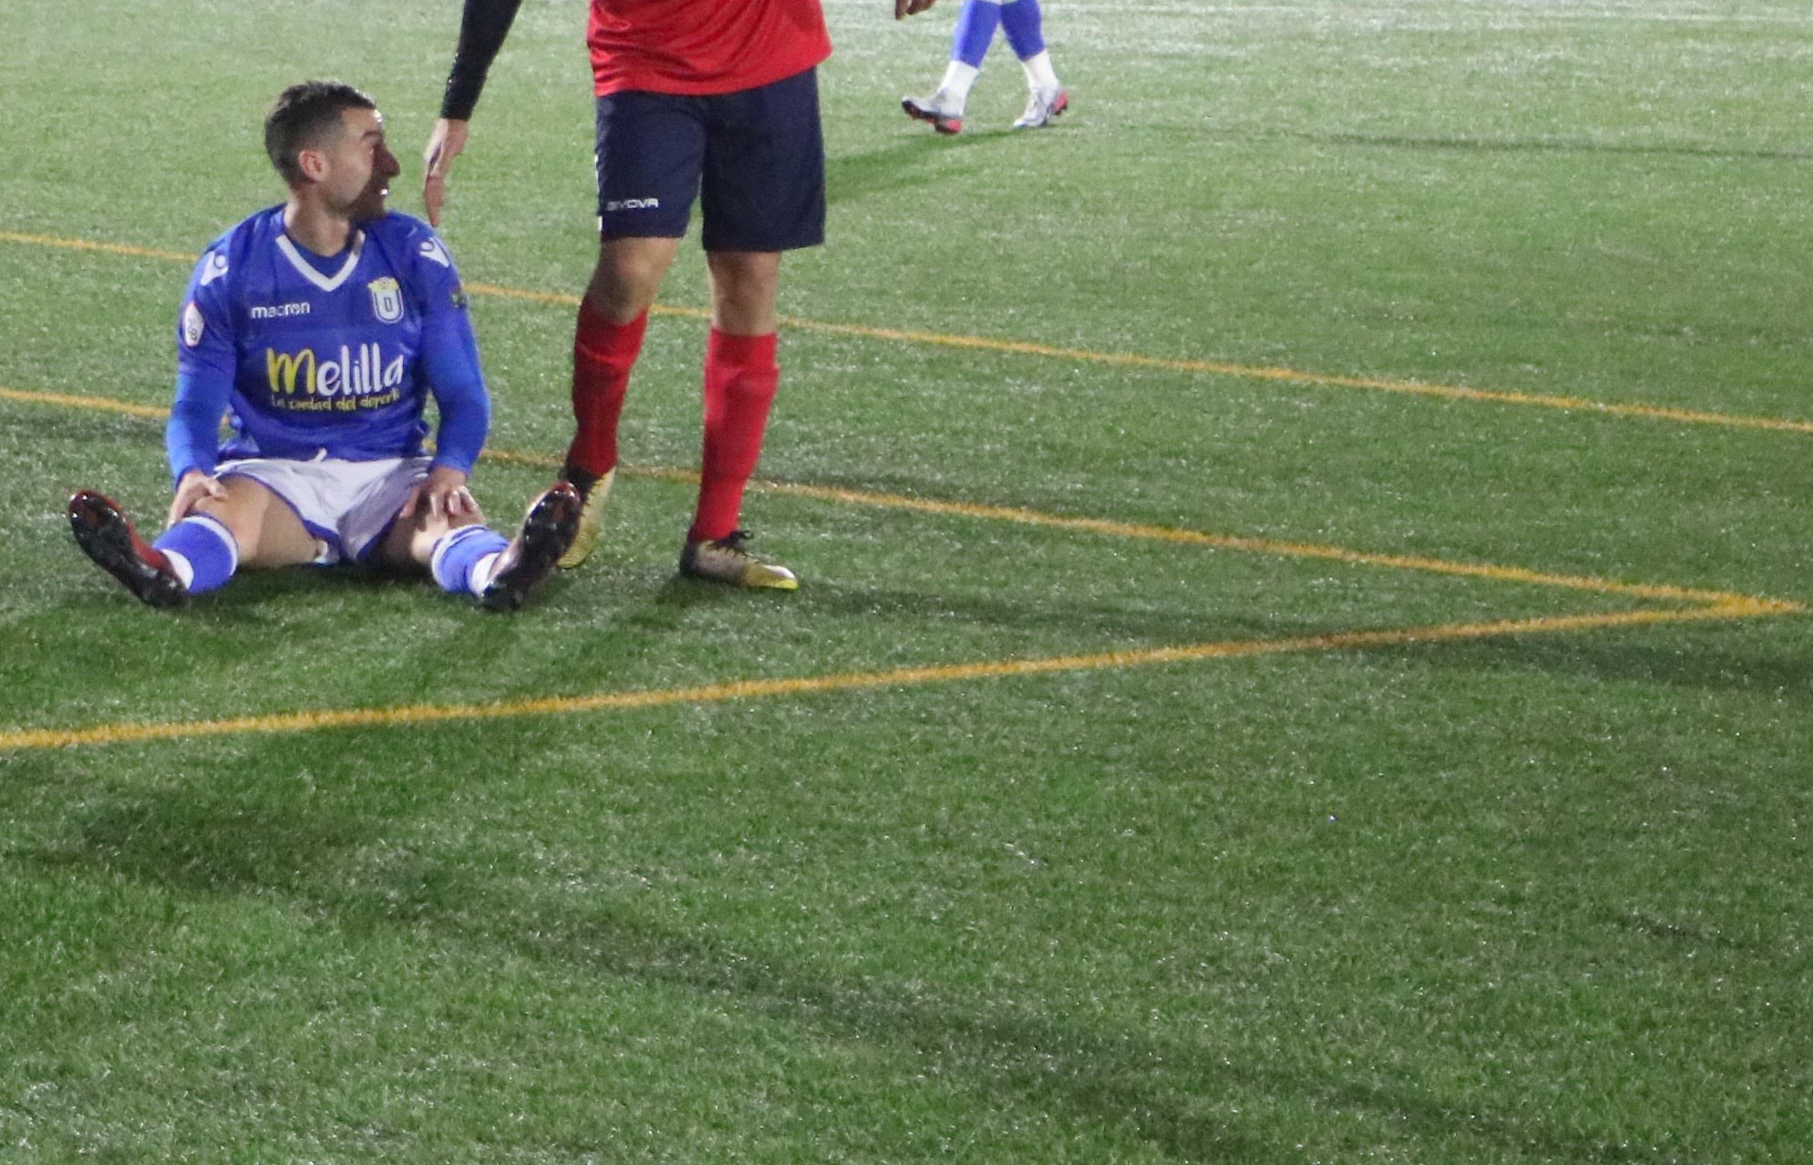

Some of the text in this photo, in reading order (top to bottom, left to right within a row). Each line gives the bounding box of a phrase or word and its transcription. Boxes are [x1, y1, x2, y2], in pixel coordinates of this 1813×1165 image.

[251, 301, 311, 319] macron
[266, 342, 405, 397] Melilla
[336, 396, 357, 411] del
